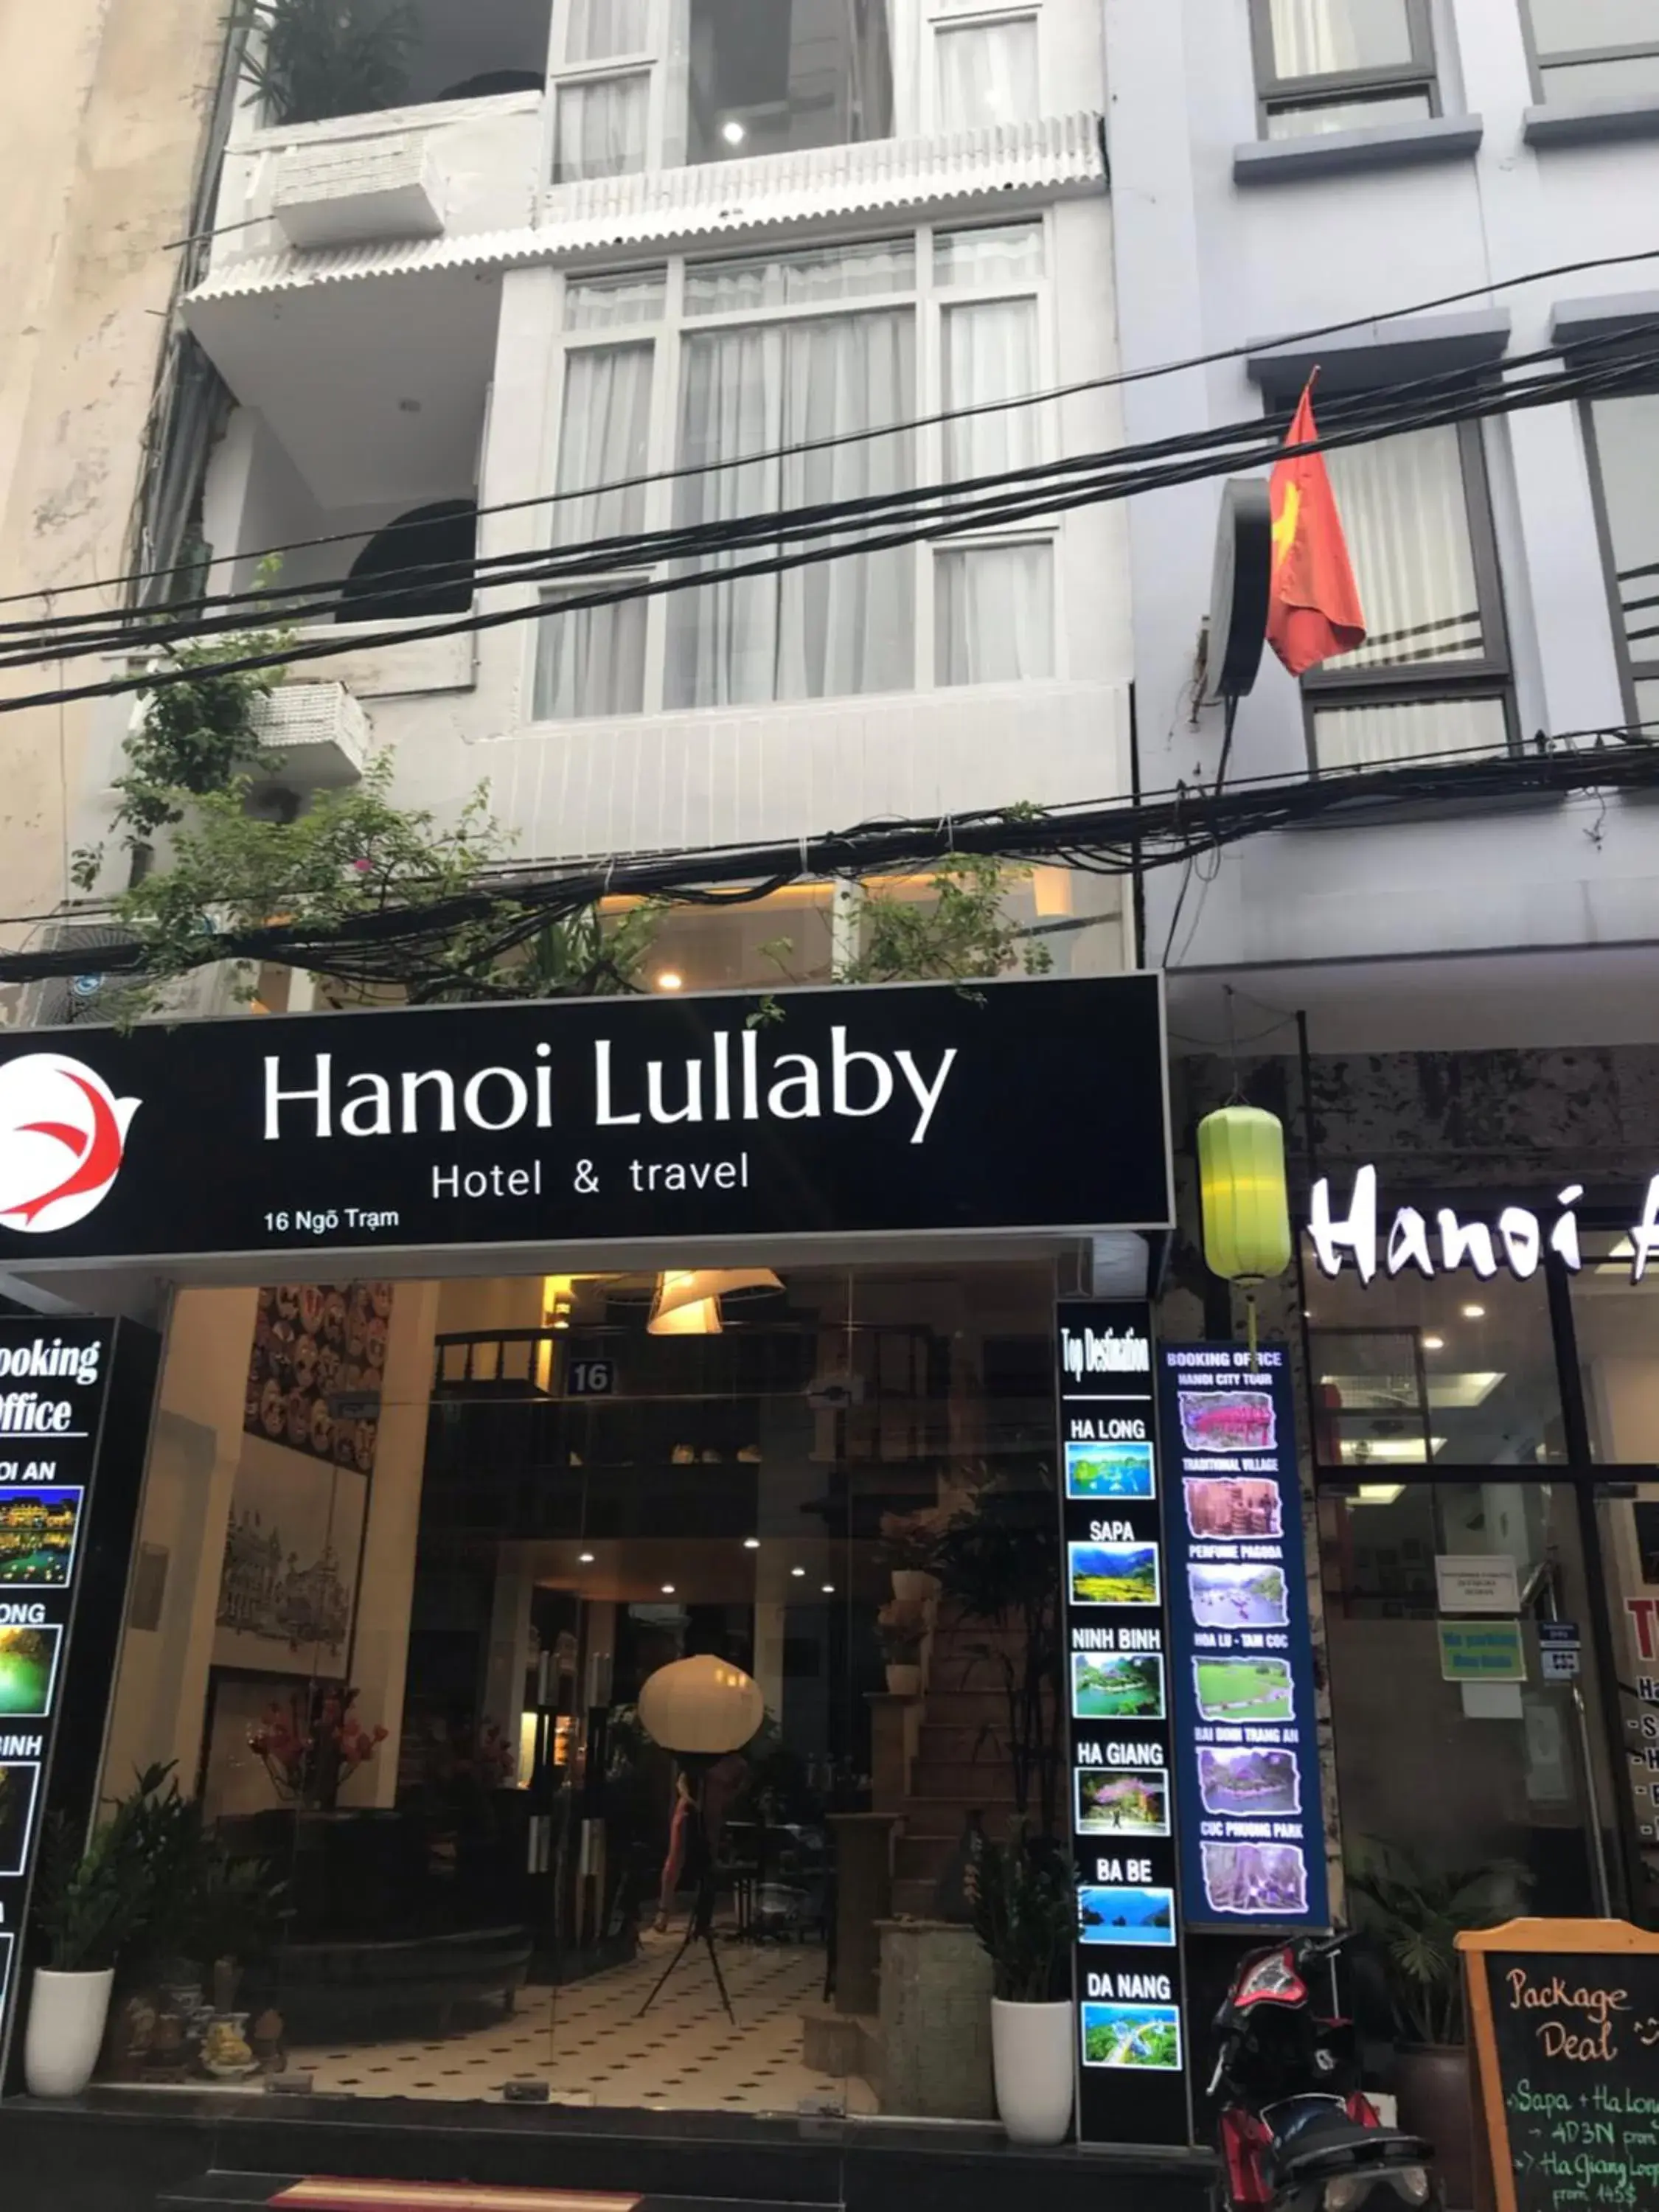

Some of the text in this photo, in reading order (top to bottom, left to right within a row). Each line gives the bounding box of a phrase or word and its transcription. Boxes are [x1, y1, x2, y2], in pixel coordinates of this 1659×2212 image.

[265, 1024, 956, 1143] Hanoi Lullaby
[433, 1152, 747, 1198] Hotel & travel
[265, 1212, 288, 1231] 16
[344, 1208, 398, 1230] Trạm
[1307, 1164, 1582, 1281] Hanoi
[574, 1363, 608, 1391] 16
[0, 1392, 72, 1431] ffice
[1071, 1419, 1145, 1439] HA LONG
[22, 1462, 56, 1480] AN
[1090, 1521, 1135, 1541] SAPA
[1072, 1628, 1161, 1649] NINH BINH
[0, 1736, 42, 1756] INH
[1078, 1742, 1164, 1765] HA GIANG
[1097, 1859, 1152, 1882] BA BE
[1088, 1973, 1171, 2000] DA NANG
[1506, 1967, 1634, 2024] Package
[1535, 2021, 1618, 2062] Deal
[1517, 2078, 1573, 2120] Sapa
